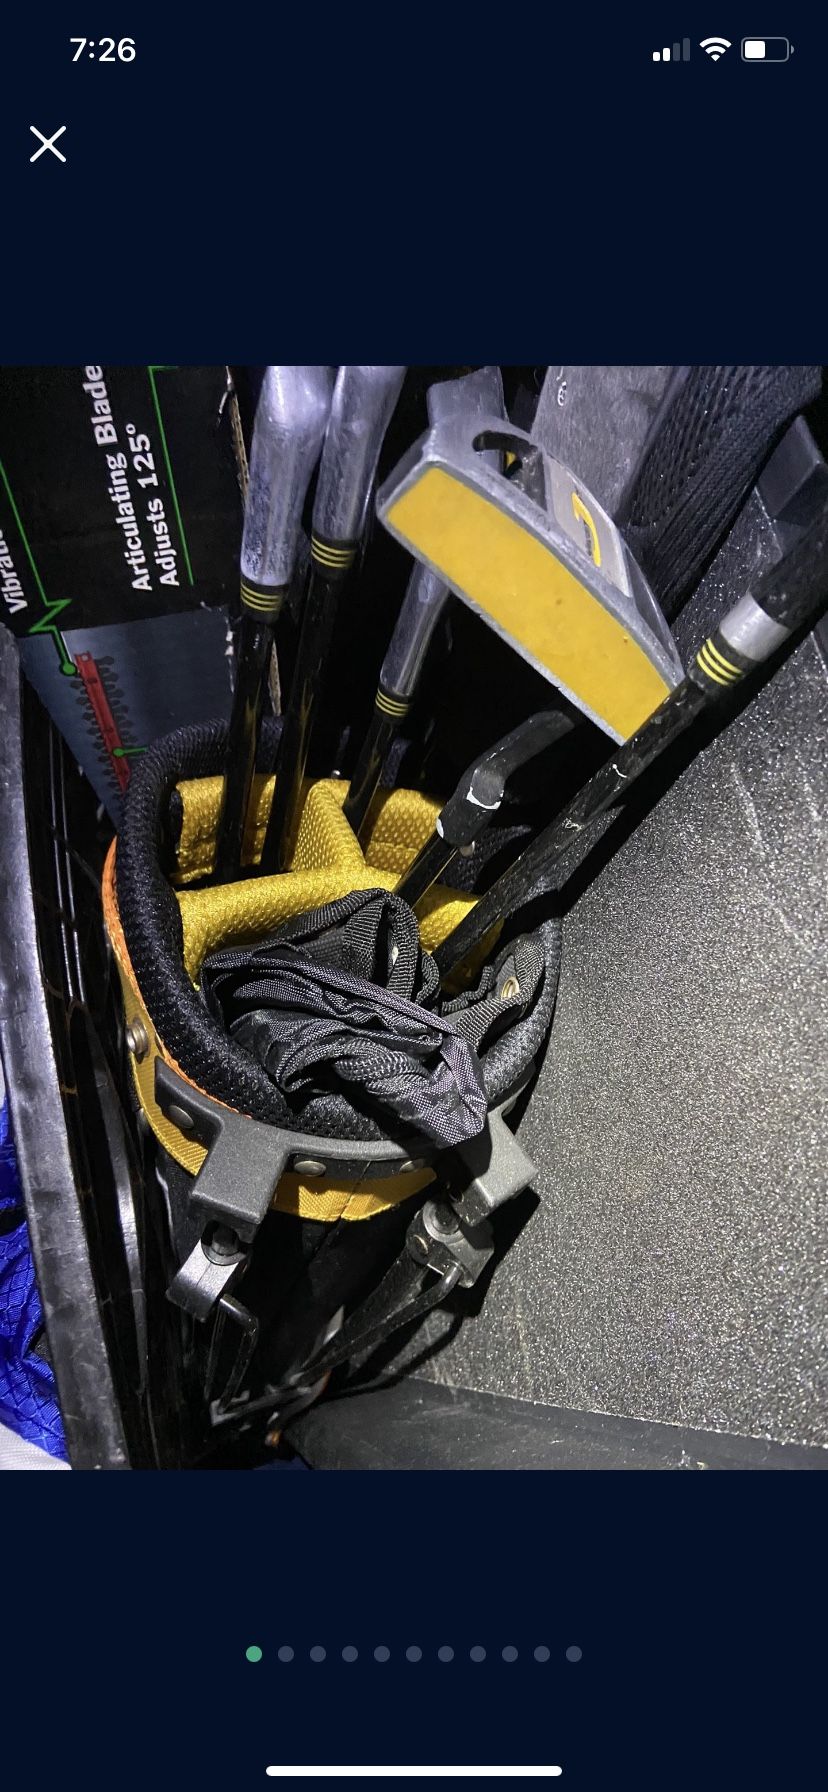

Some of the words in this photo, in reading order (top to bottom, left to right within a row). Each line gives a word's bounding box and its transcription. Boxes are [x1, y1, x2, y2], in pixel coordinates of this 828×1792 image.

[82, 366, 118, 446] Blade
[125, 423, 159, 489] 125°
[105, 452, 153, 591] Articulating
[146, 498, 180, 587] Adjusts
